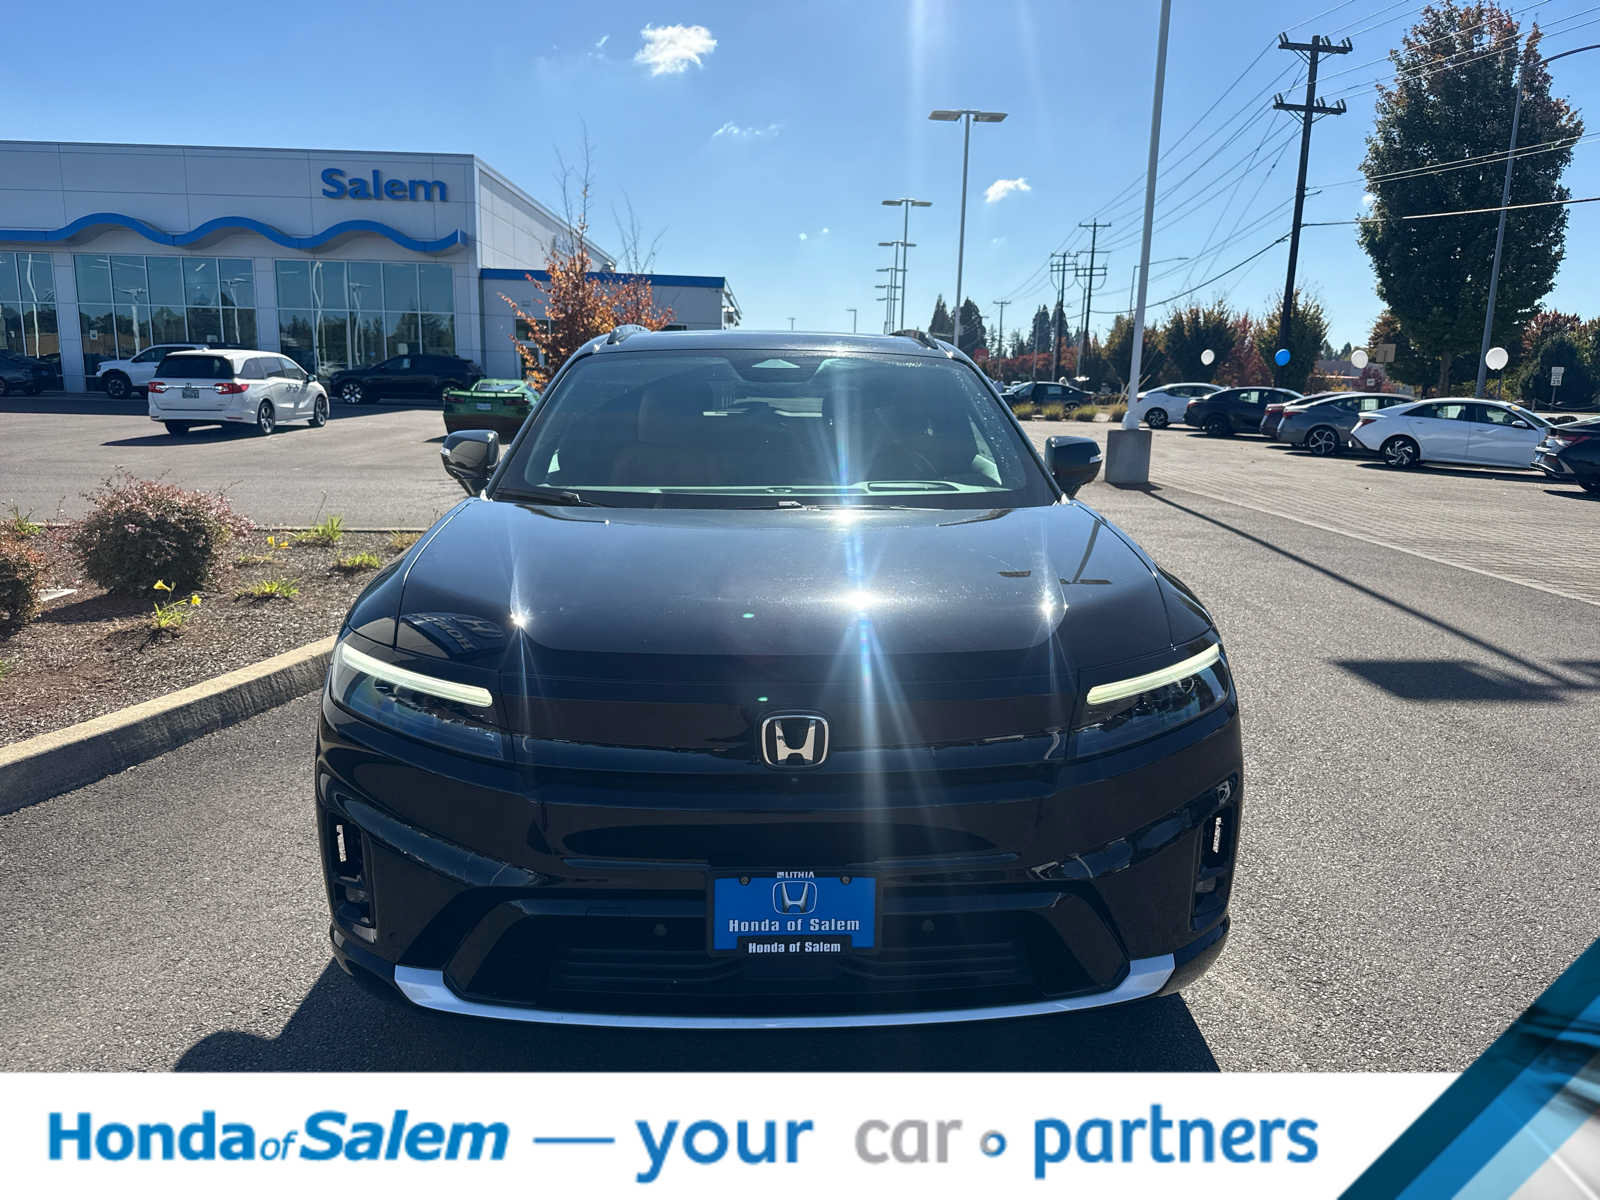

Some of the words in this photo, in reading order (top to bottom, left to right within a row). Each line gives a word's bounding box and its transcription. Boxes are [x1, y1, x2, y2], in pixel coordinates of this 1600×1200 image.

[320, 167, 448, 201] Salem
[785, 871, 815, 879] LITHIA
[729, 919, 780, 932] Honda
[787, 919, 803, 931] of
[809, 918, 860, 931] Salem
[748, 942, 785, 954] Honda
[789, 942, 801, 953] of
[804, 941, 841, 953] Salem
